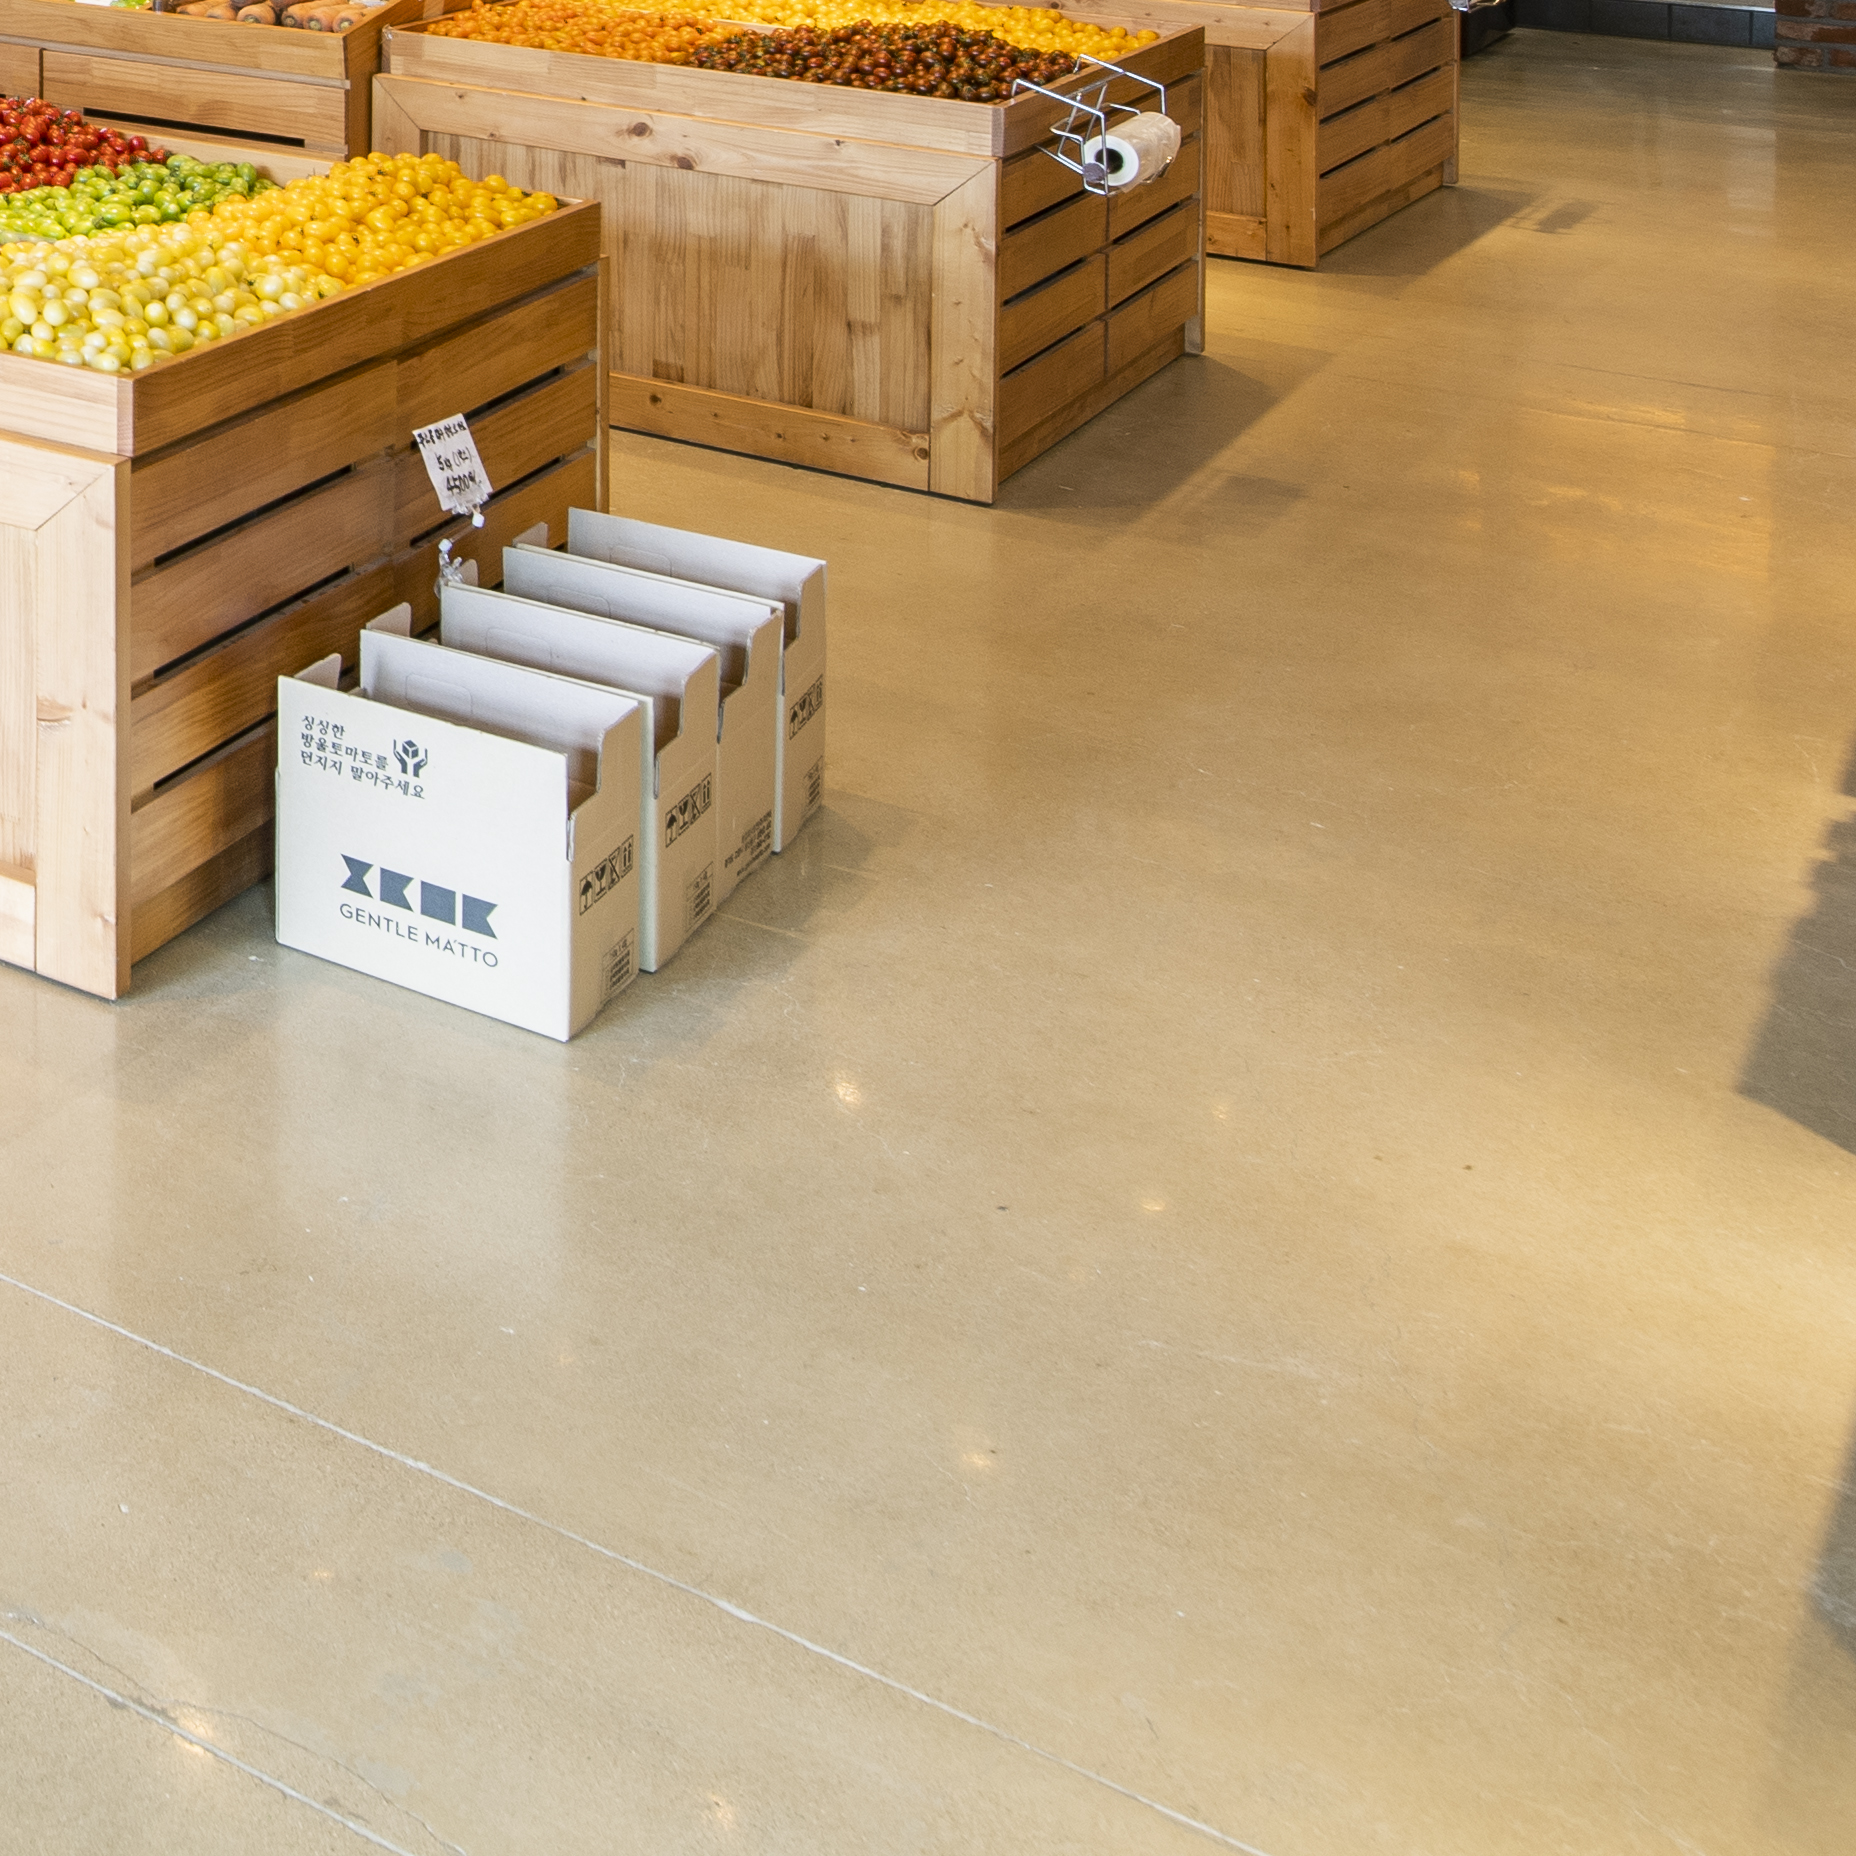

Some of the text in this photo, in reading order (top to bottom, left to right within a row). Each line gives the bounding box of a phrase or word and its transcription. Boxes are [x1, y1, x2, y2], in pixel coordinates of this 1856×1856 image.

[301, 714, 345, 740] 싱싱한
[300, 732, 389, 772] 방울토마토를
[300, 749, 426, 800] 던지지 말아주세요
[339, 902, 420, 943] GENTLE
